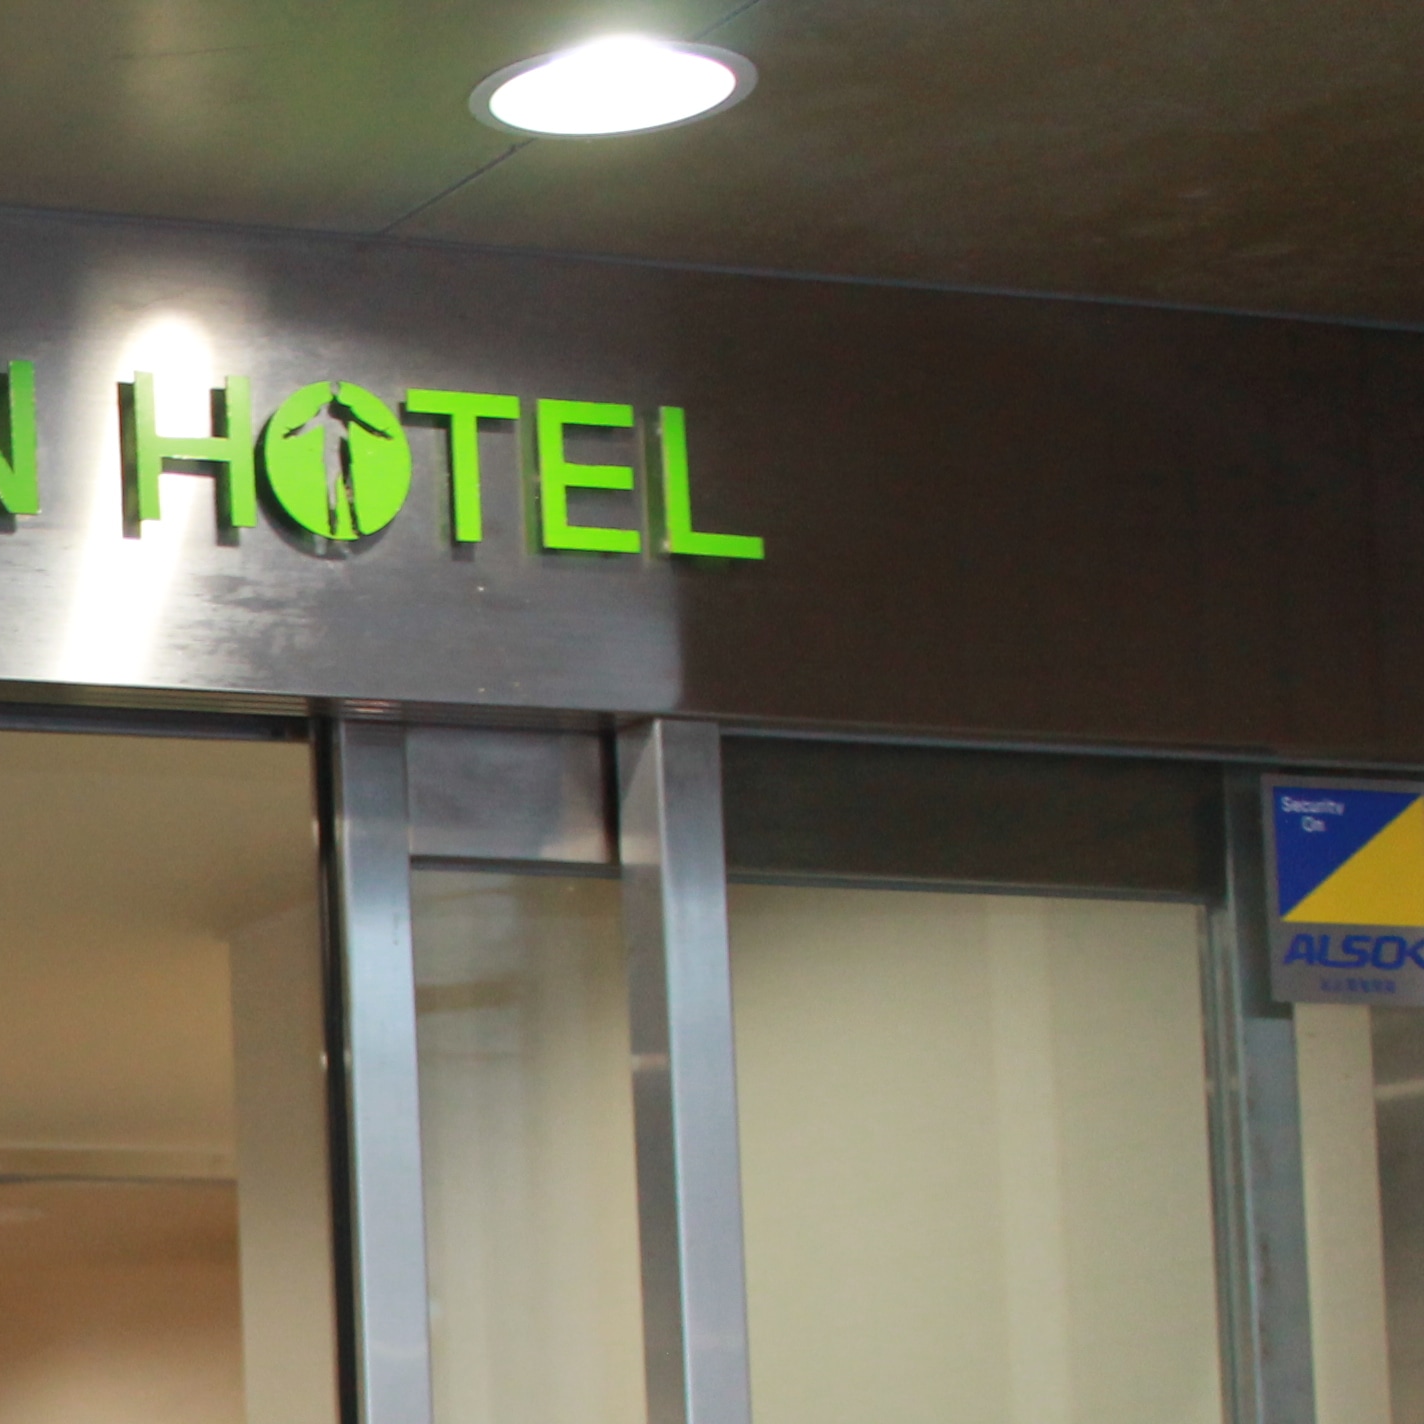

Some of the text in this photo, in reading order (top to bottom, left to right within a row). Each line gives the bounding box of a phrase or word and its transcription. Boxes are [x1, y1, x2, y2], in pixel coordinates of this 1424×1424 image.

[133, 369, 765, 561] HOTEL
[1280, 796, 1345, 816] Security
[1302, 815, 1326, 833] On
[1283, 932, 1424, 972] ALSOK
